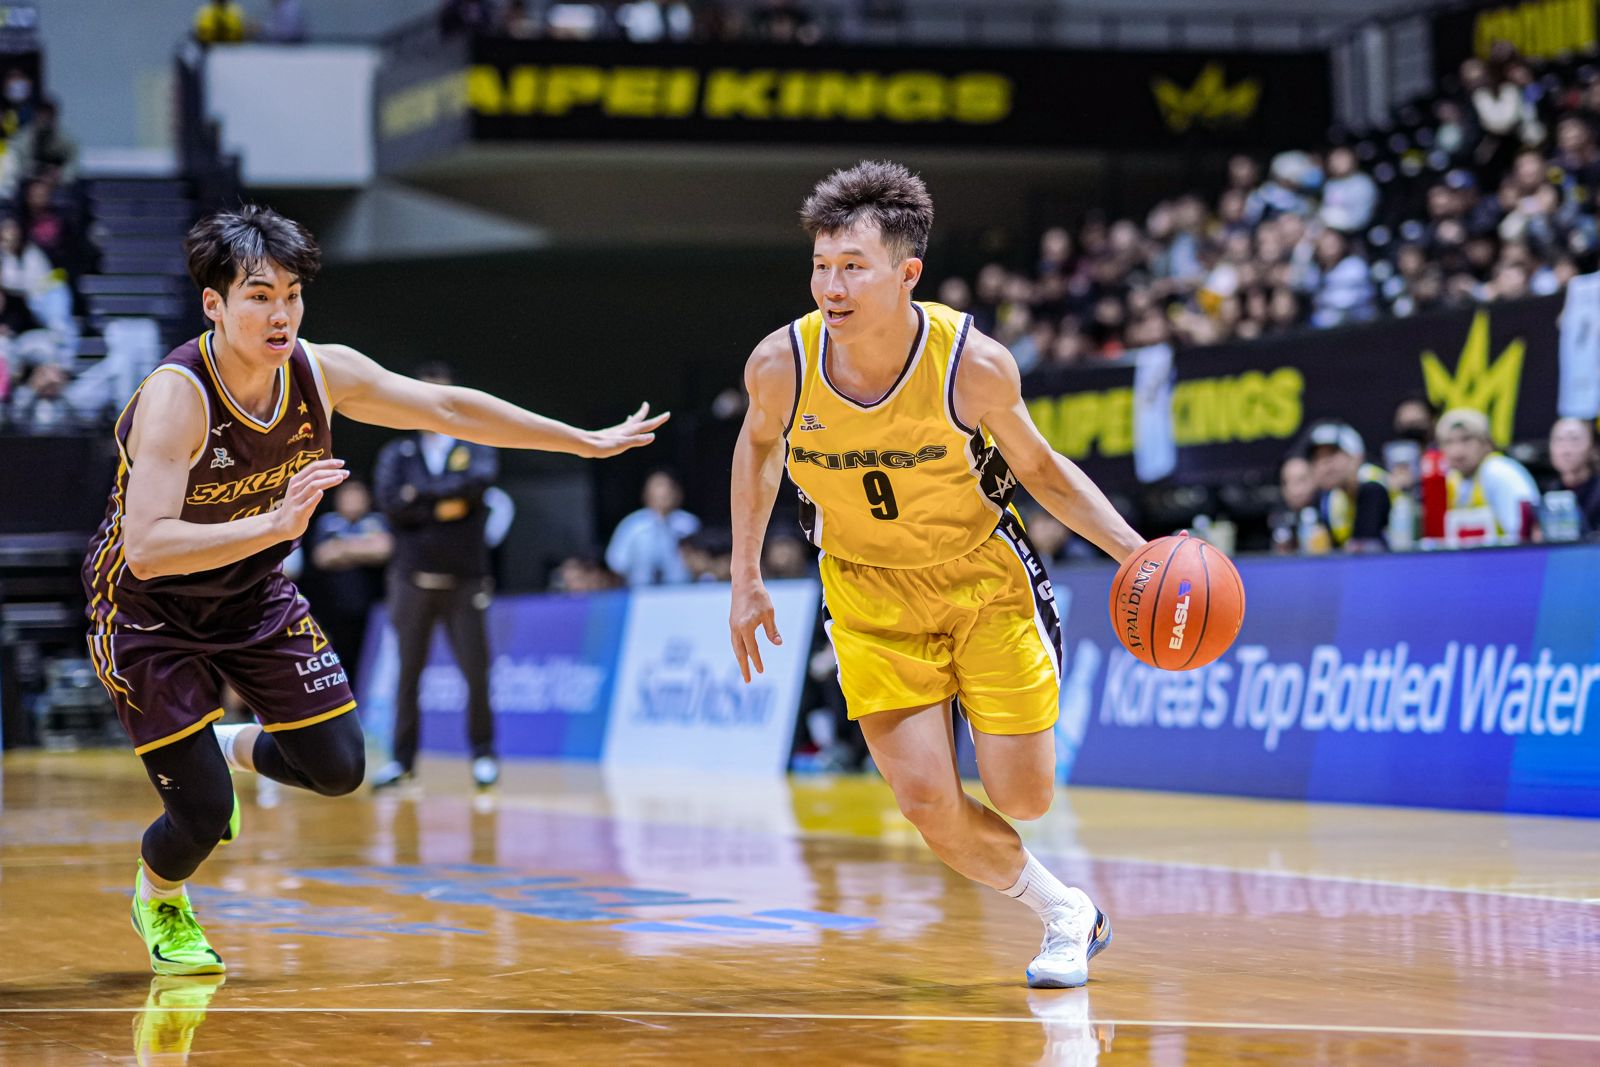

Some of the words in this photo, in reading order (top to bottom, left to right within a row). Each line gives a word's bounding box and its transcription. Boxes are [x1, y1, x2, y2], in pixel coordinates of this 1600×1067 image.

[703, 68, 1012, 122] KINGS
[800, 423, 826, 431] EASL
[792, 446, 948, 471] KINGS
[862, 470, 900, 521] 9
[1127, 559, 1161, 652] SPALDING
[1168, 595, 1191, 651] EASL
[295, 657, 322, 676] LG
[1099, 645, 1234, 729] Koreas
[1232, 644, 1305, 752] Top
[1301, 640, 1459, 733] Bottled
[1459, 643, 1600, 736] Water
